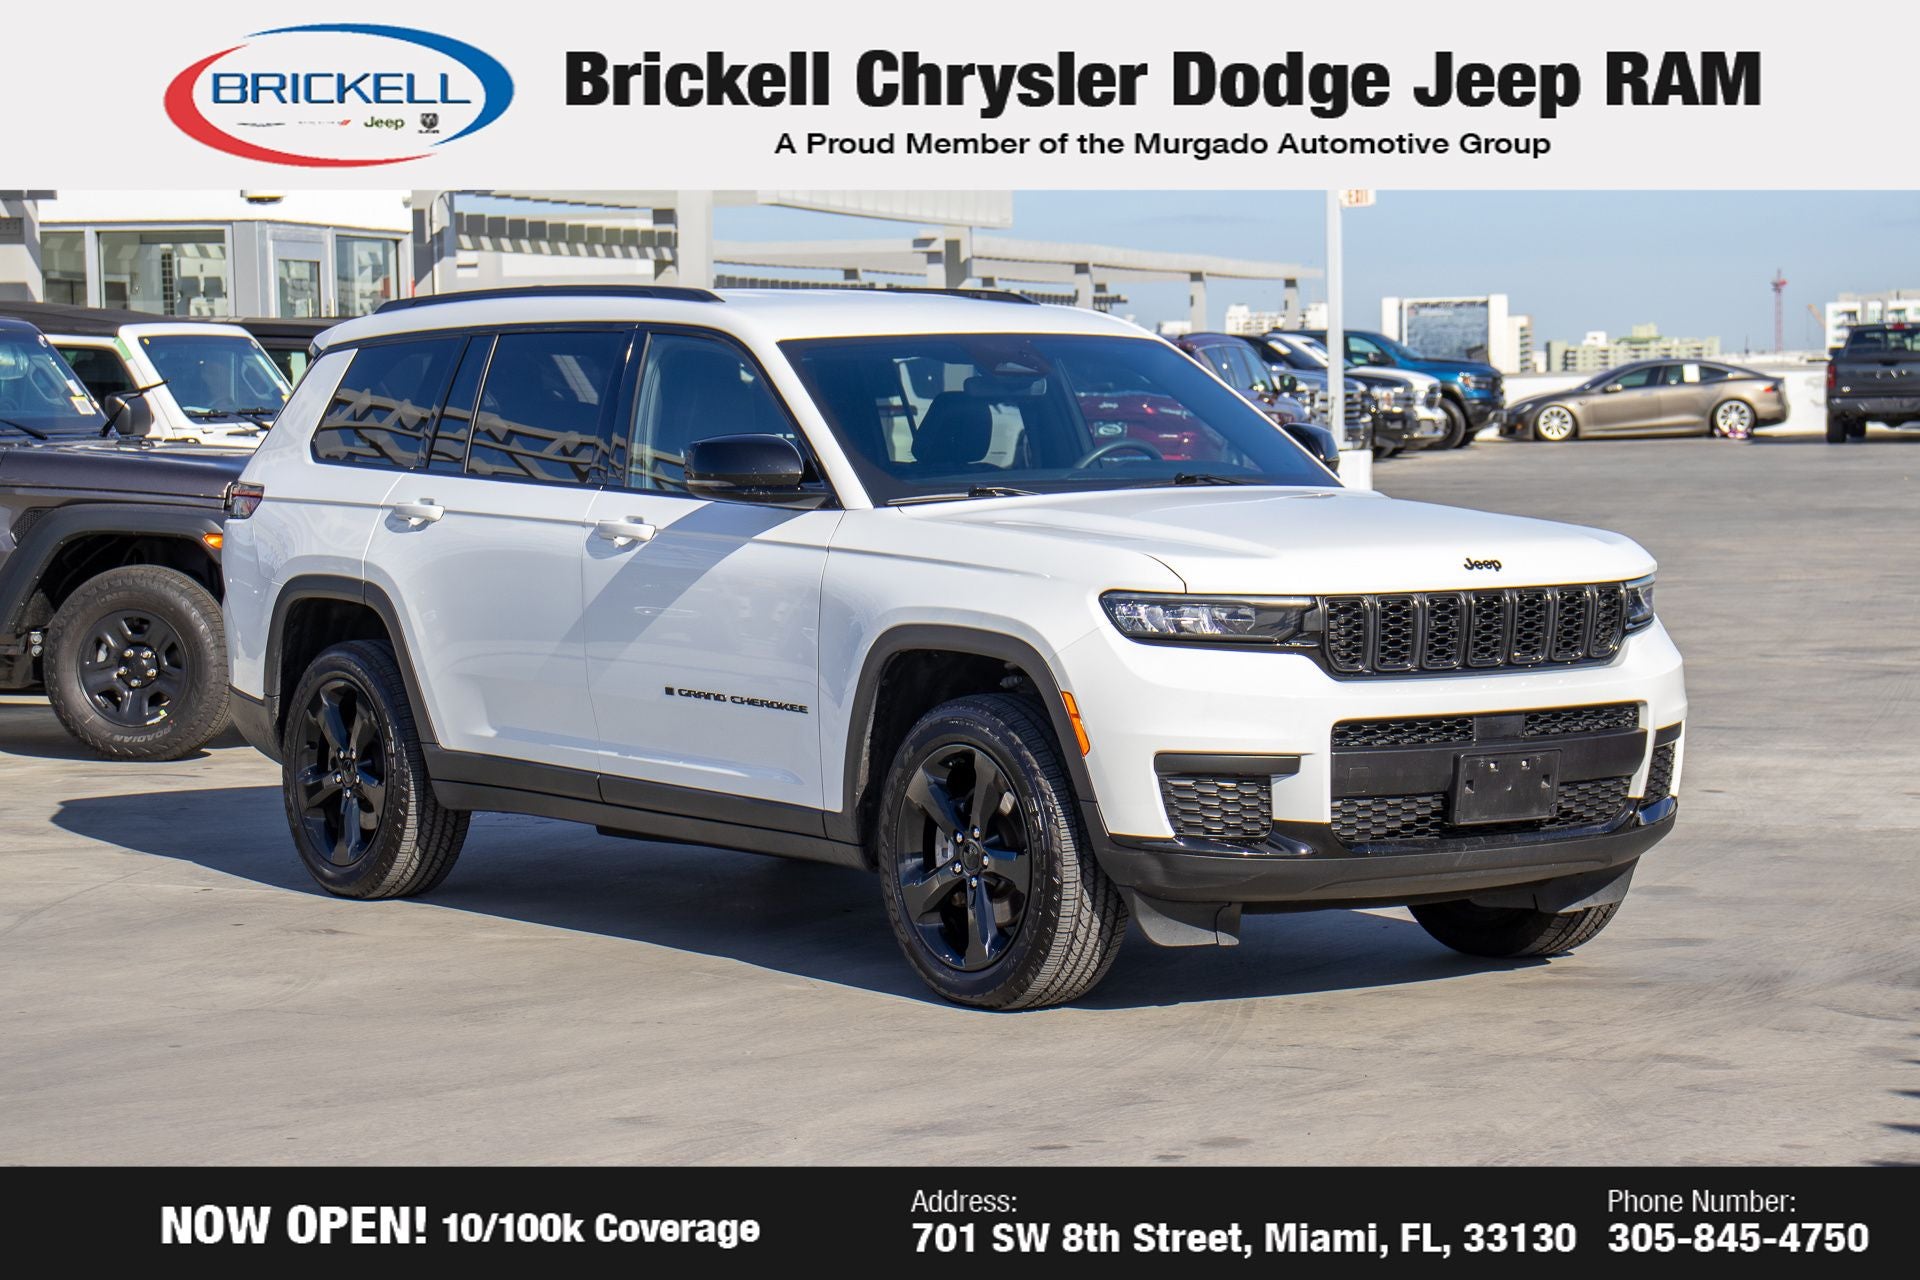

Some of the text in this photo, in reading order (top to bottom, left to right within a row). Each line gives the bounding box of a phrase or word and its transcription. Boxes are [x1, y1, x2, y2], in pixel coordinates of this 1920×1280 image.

[1464, 557, 1502, 571] Jeep
[677, 688, 809, 714] GRAND CHEROKEE
